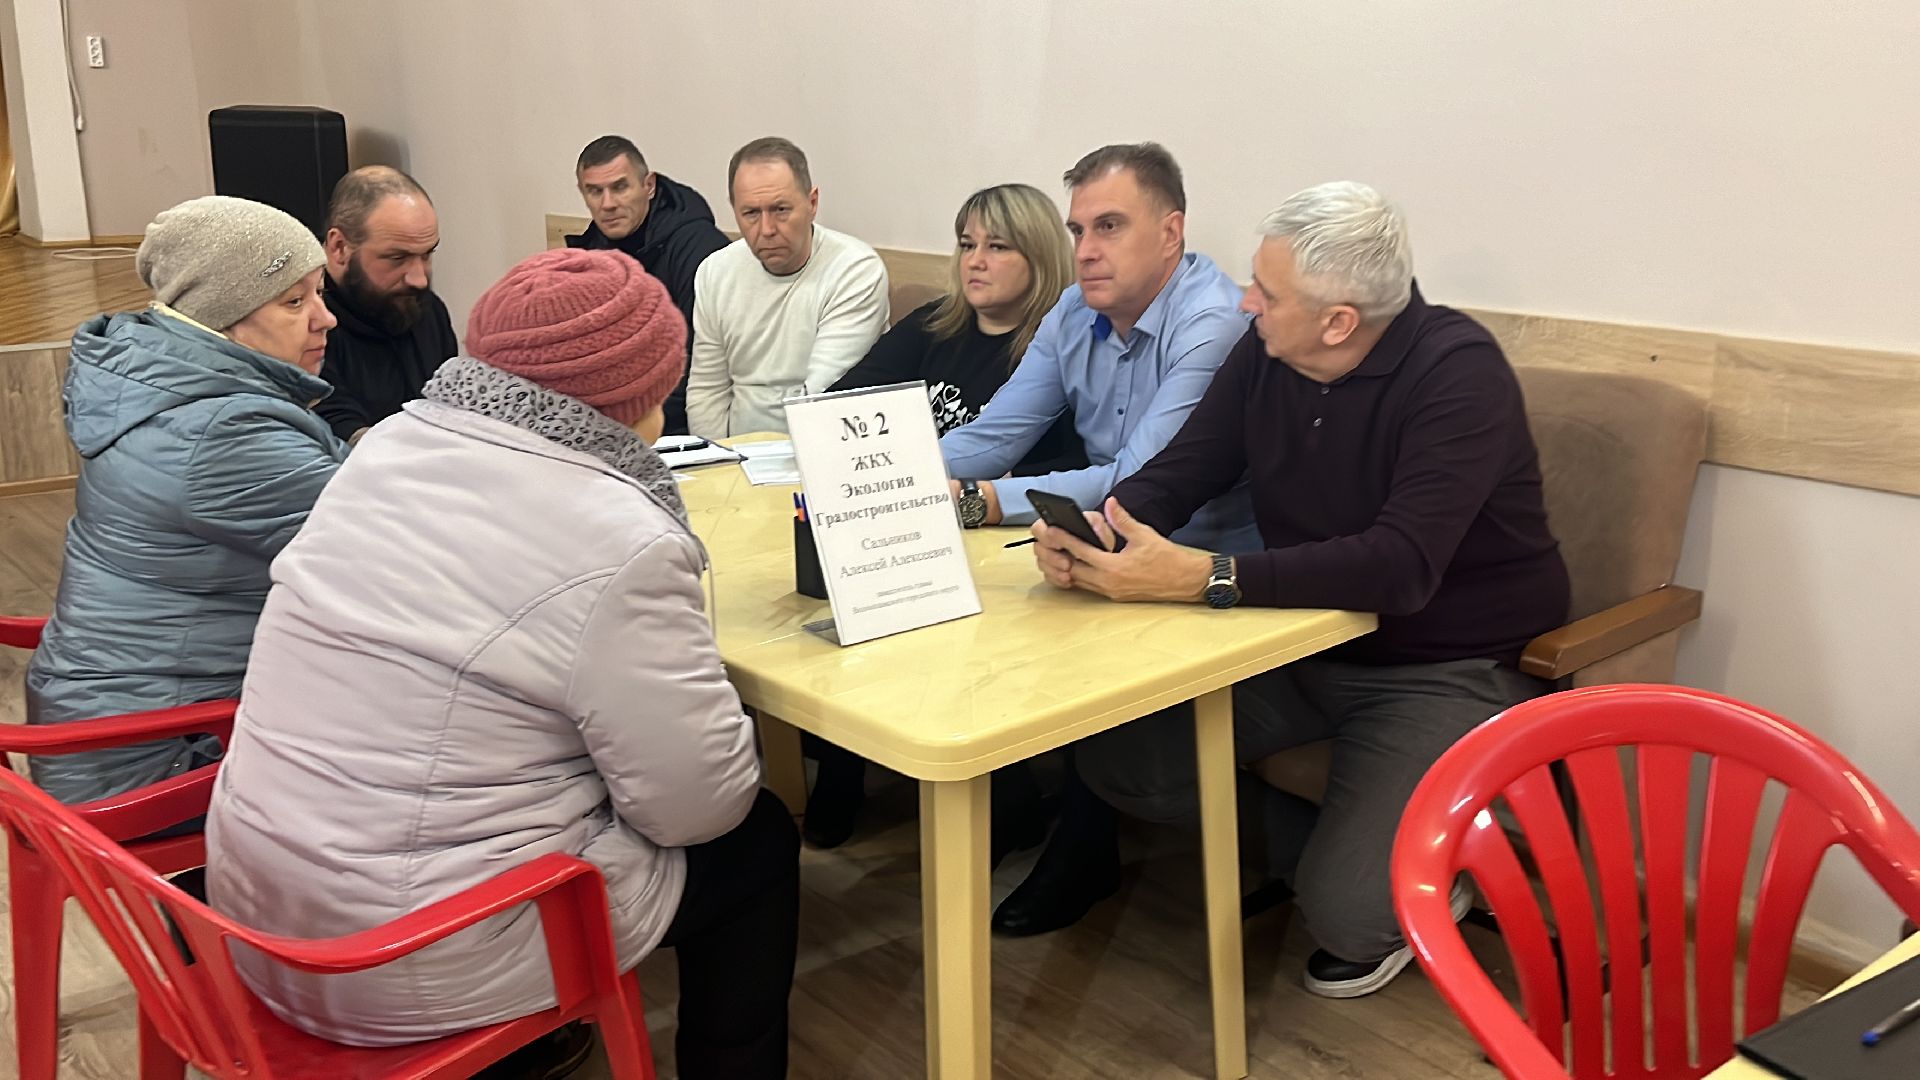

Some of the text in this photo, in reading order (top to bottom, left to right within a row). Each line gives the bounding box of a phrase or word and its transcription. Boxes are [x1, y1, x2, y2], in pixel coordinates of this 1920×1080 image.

[840, 412, 890, 442] № 2
[852, 451, 894, 471] ЖКХ
[841, 475, 915, 499] Экология
[815, 492, 949, 528] Градостроительство
[840, 557, 888, 579] Алексей
